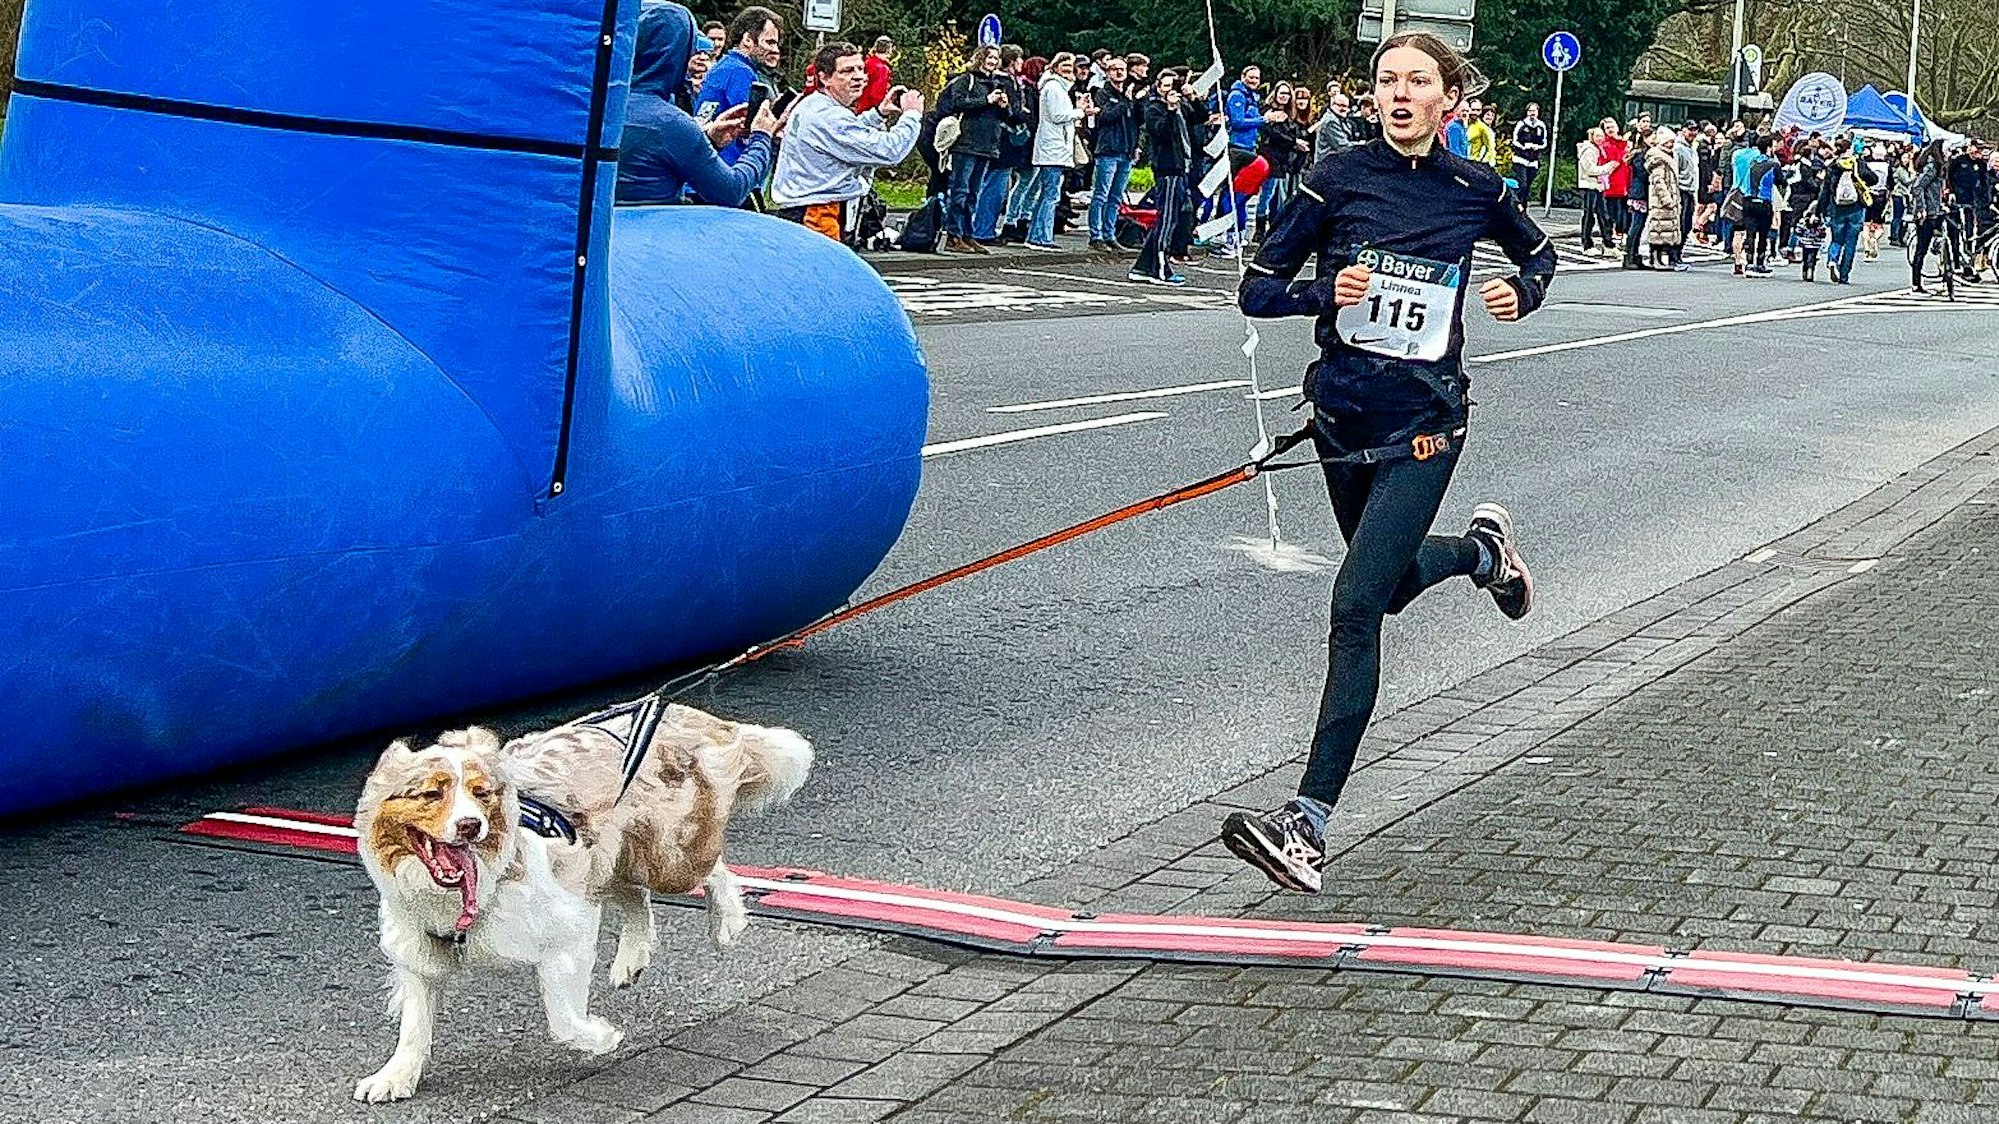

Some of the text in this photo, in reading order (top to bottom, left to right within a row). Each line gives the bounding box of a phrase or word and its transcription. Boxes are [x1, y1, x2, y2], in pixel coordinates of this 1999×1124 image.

[1381, 255, 1435, 280] Bayer
[1380, 280, 1422, 296] Linnea
[1367, 294, 1427, 332] 115
